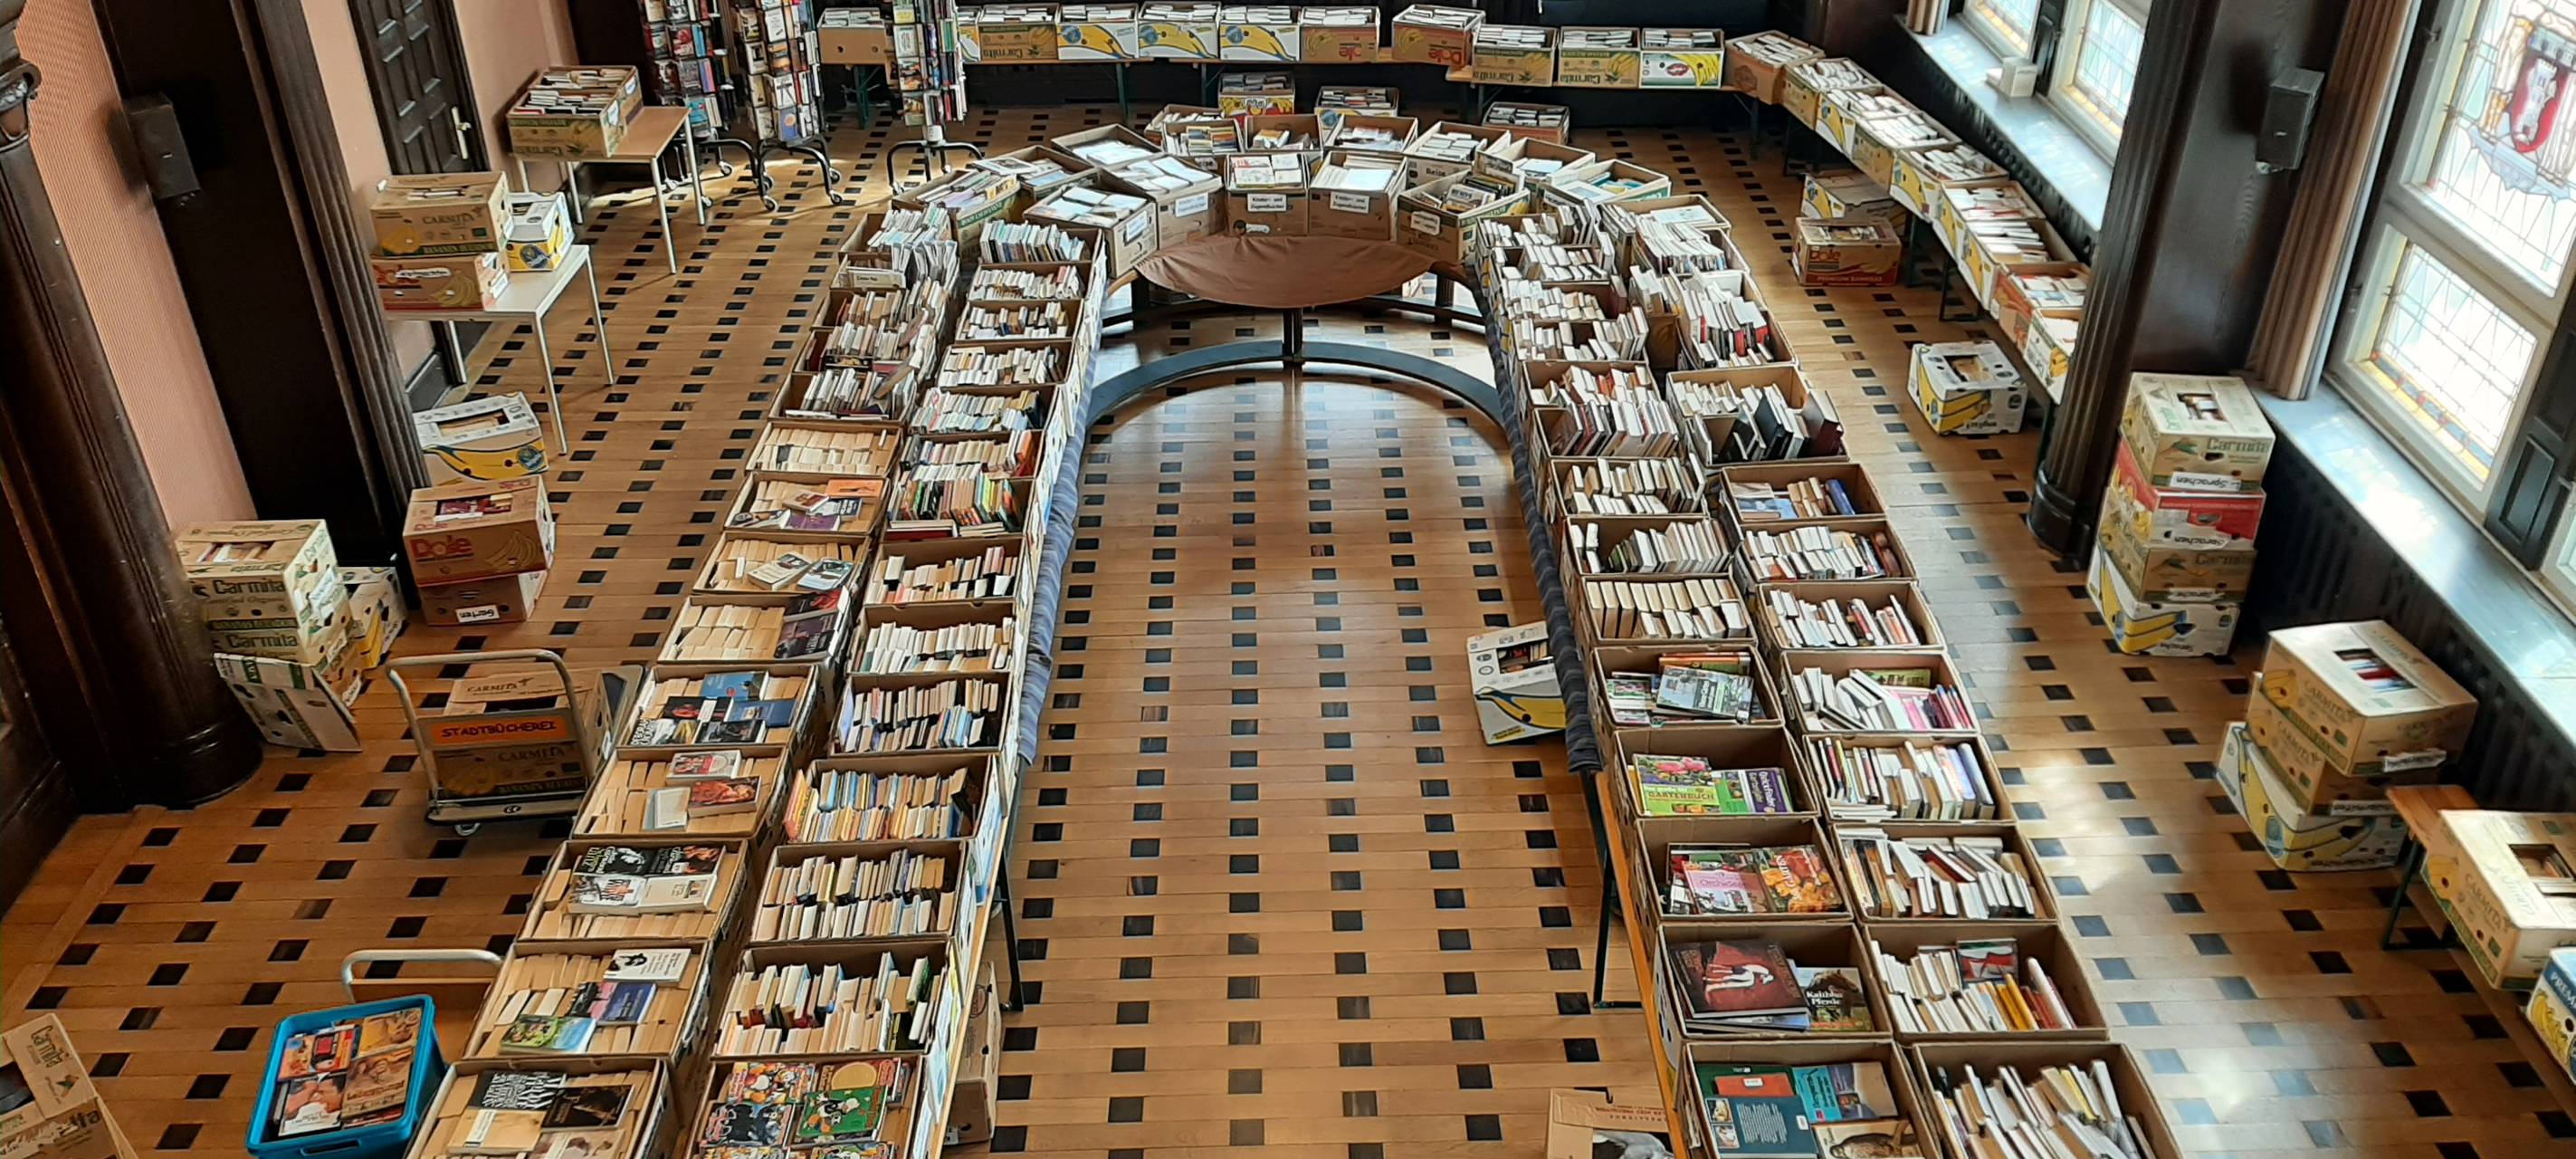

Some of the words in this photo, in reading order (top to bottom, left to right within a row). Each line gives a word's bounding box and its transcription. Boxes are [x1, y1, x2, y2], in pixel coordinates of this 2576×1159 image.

[1427, 48, 1462, 65] Dole
[1560, 72, 1601, 84] Carmita
[2176, 476, 2228, 489] Sprachen
[410, 535, 472, 558] Dole
[213, 579, 285, 594] Carmita
[459, 608, 495, 619] Garten
[226, 634, 298, 648] Carmita
[467, 682, 518, 694] CARMITA
[442, 720, 558, 738] STADTBÜCHEREI
[499, 746, 565, 762] CARMITA
[1648, 790, 1714, 800] GARTENBUCH
[2465, 873, 2503, 930] CARMITA
[2550, 971, 2576, 1010] PREM
[31, 1025, 65, 1068] Carmita
